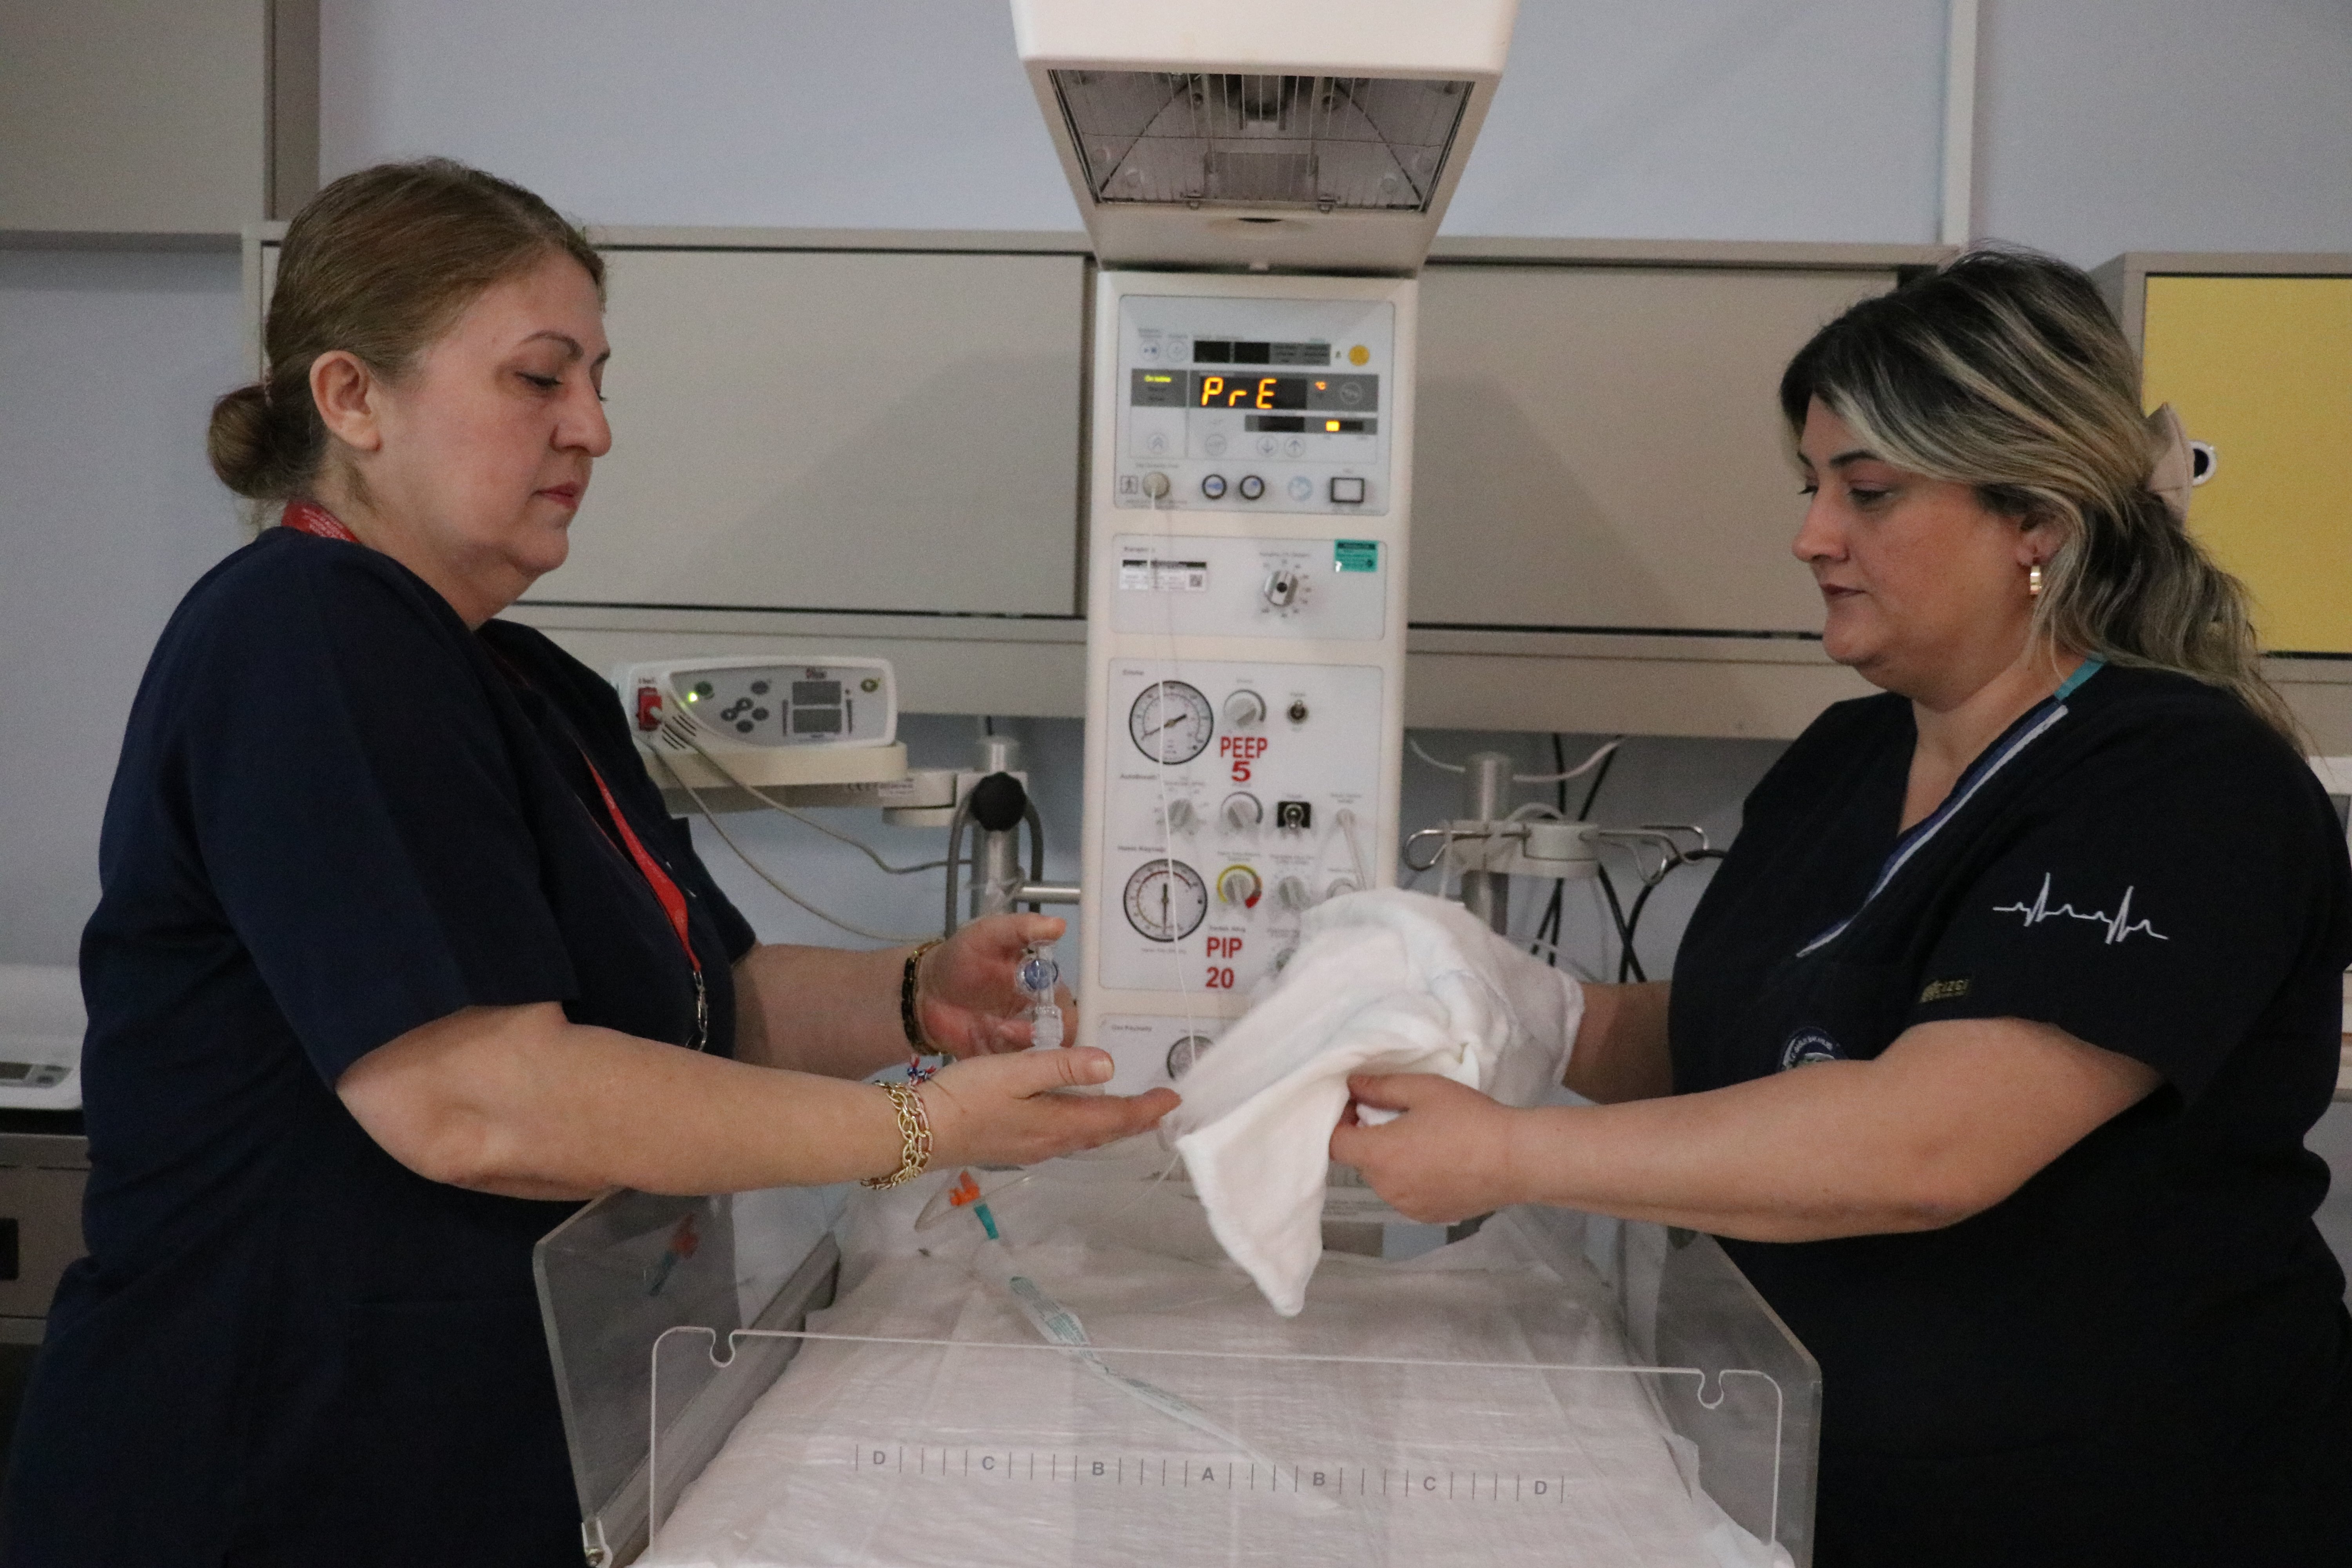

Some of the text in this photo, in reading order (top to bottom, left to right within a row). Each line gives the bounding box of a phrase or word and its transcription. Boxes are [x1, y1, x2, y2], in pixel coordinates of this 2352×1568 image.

[1200, 376, 1278, 410] PrE
[1220, 736, 1268, 759] PEEP
[1232, 760, 1251, 782] 5
[1206, 936, 1243, 959] PIP
[1205, 966, 1235, 989] 20
[873, 1450, 1548, 1495] D C B A B C D
